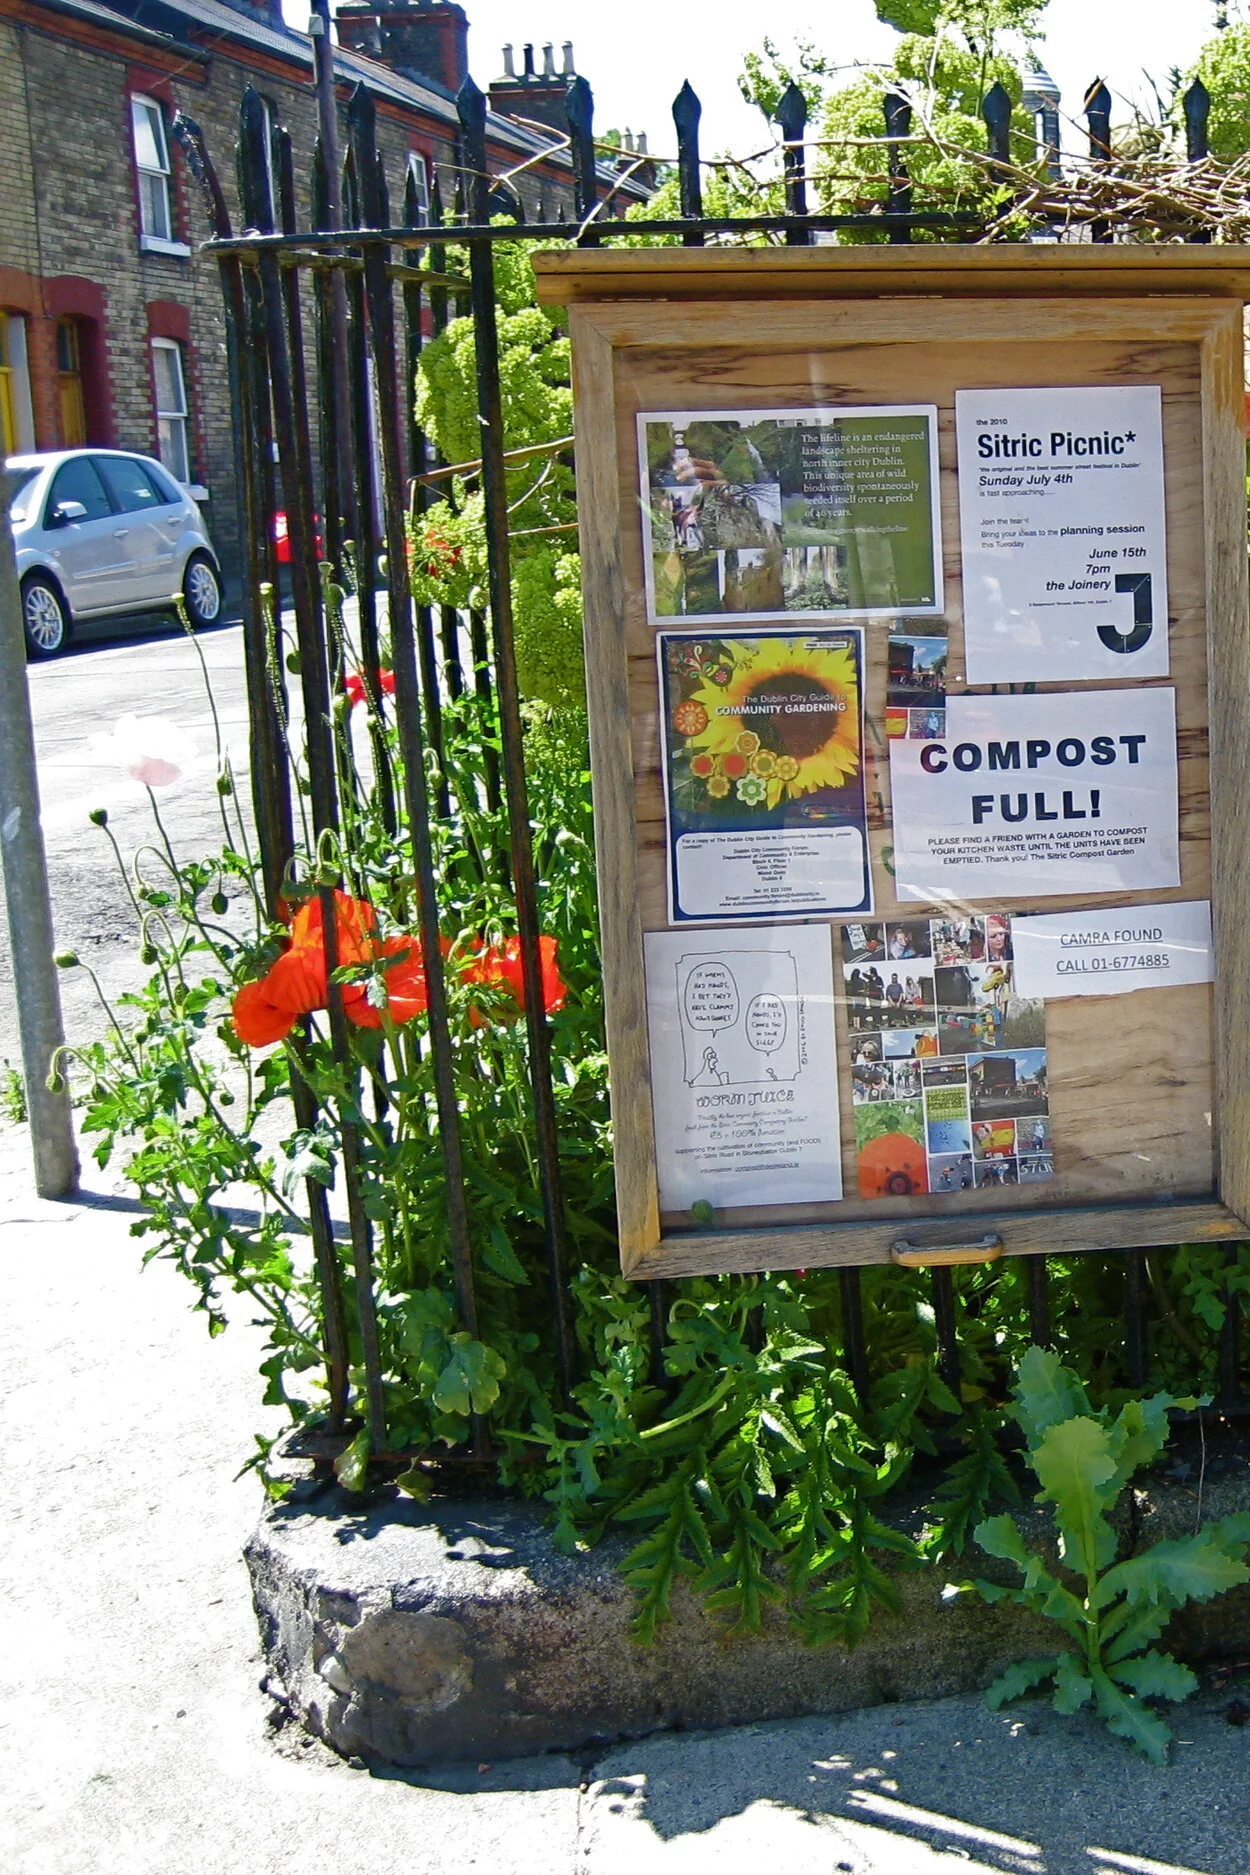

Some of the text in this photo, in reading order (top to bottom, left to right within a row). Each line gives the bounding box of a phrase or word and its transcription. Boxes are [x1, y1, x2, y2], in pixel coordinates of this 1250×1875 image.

[801, 434, 818, 443] The
[820, 433, 851, 442] lifeline
[853, 433, 860, 441] is
[874, 431, 925, 442] endangered
[802, 444, 901, 456] landscape sheltering in
[978, 433, 1042, 458] Sitric
[803, 459, 827, 467] north
[854, 458, 870, 468] city
[873, 457, 905, 465] Dublin.
[803, 471, 822, 480] This
[824, 472, 855, 481] unique
[876, 469, 885, 477] of
[887, 469, 906, 477] wild
[979, 473, 1073, 487] Sunday July 4th
[803, 481, 919, 493] biodiversity spontaneously
[834, 495, 856, 503] itself
[885, 493, 913, 504] period
[804, 509, 814, 517] of
[1060, 526, 1103, 537] planning
[1106, 525, 1145, 534] session
[1089, 547, 1146, 559] June 15th
[1086, 564, 1111, 576] 7pm
[1046, 580, 1111, 591] the Joinery
[743, 695, 757, 703] The
[761, 694, 787, 703] Dublin
[790, 694, 807, 703] City
[809, 693, 834, 701] Guide
[715, 703, 846, 715] COMMUNITY GARDENING
[920, 735, 1146, 773] COMPOST
[971, 790, 1101, 824] FULL!
[928, 837, 960, 845] PLEASE
[992, 834, 1023, 842] FRIEND
[1056, 831, 1092, 839] GARDEN
[1107, 827, 1147, 836] COMPOST
[931, 847, 956, 855] YOUR
[958, 846, 995, 854] KITCHEN
[997, 844, 1025, 852] WASTE
[1028, 843, 1052, 851] UNTIL
[1073, 840, 1098, 848] UNITS
[1124, 837, 1145, 845] BEEN
[944, 856, 983, 864] EMPTIED.
[986, 855, 1009, 863] Thank
[1011, 854, 1028, 862] you!
[1069, 850, 1104, 859] Compost
[1107, 848, 1134, 856] Garden
[1060, 928, 1162, 945] CAMRA FOUND
[1056, 954, 1169, 972] CALL 01-6774885
[696, 1089, 795, 1108] WORM JUICE
